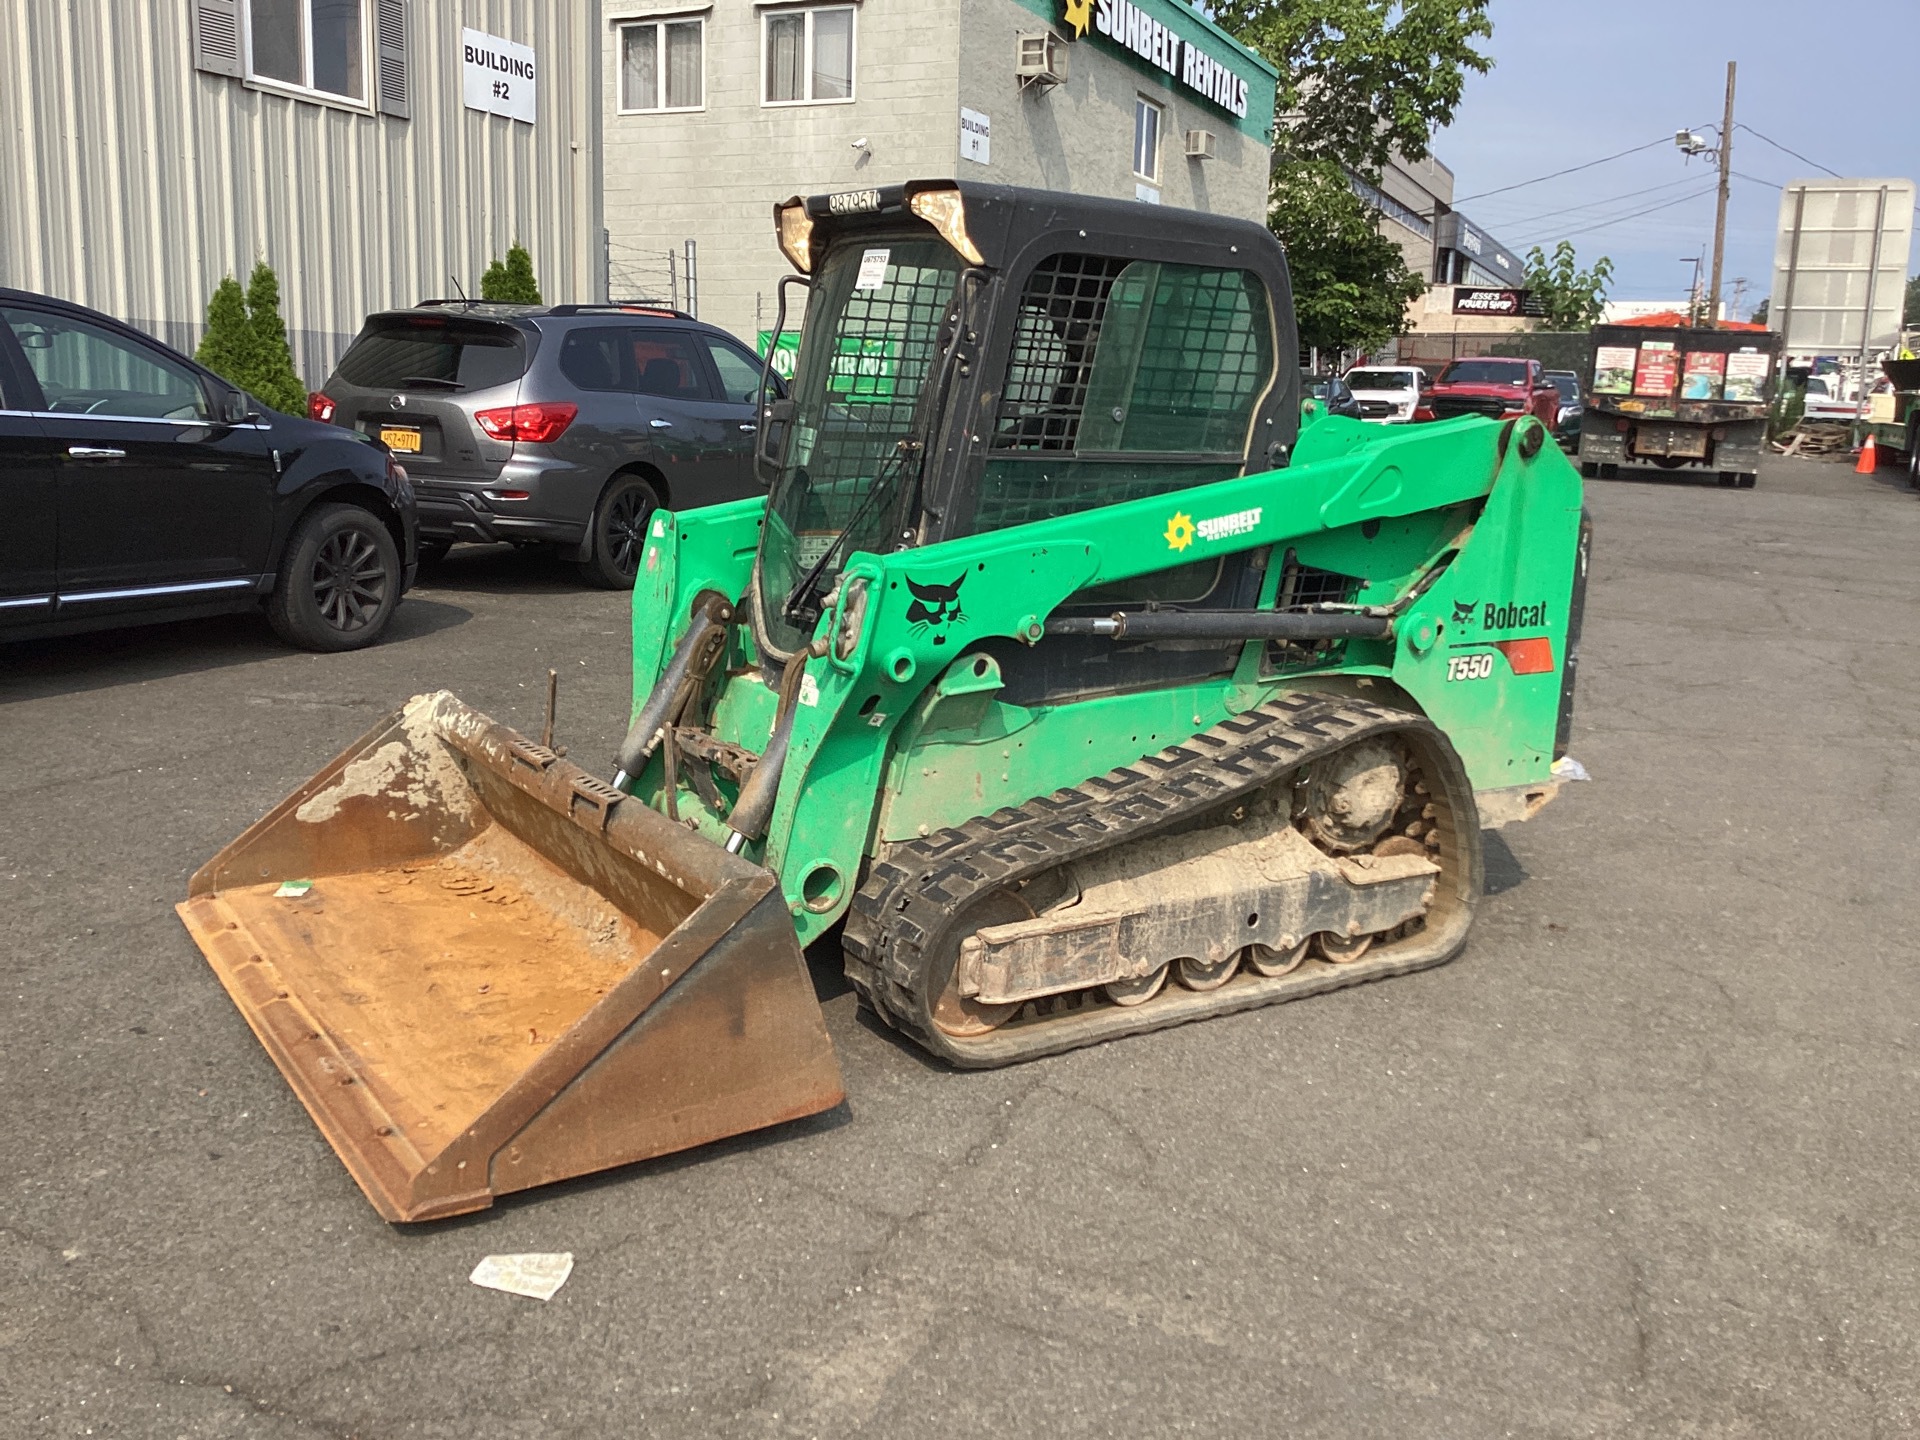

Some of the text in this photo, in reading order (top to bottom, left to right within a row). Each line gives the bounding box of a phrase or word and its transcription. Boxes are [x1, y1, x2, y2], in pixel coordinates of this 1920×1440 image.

[464, 45, 534, 80] BUILDING
[1096, 0, 1248, 119] SUNBELT RENTALS
[492, 80, 510, 100] #2
[961, 117, 990, 138] BUILDING
[972, 139, 979, 151] #1
[830, 191, 876, 214] 987957
[1457, 299, 1488, 309] POWER
[1489, 301, 1512, 310] SHOP
[1470, 292, 1500, 301] JESSE'S
[1197, 507, 1263, 538] SUNBELT
[1206, 525, 1254, 542] RENTALS
[1483, 600, 1547, 631] Bobcat
[1447, 652, 1494, 682] T550
